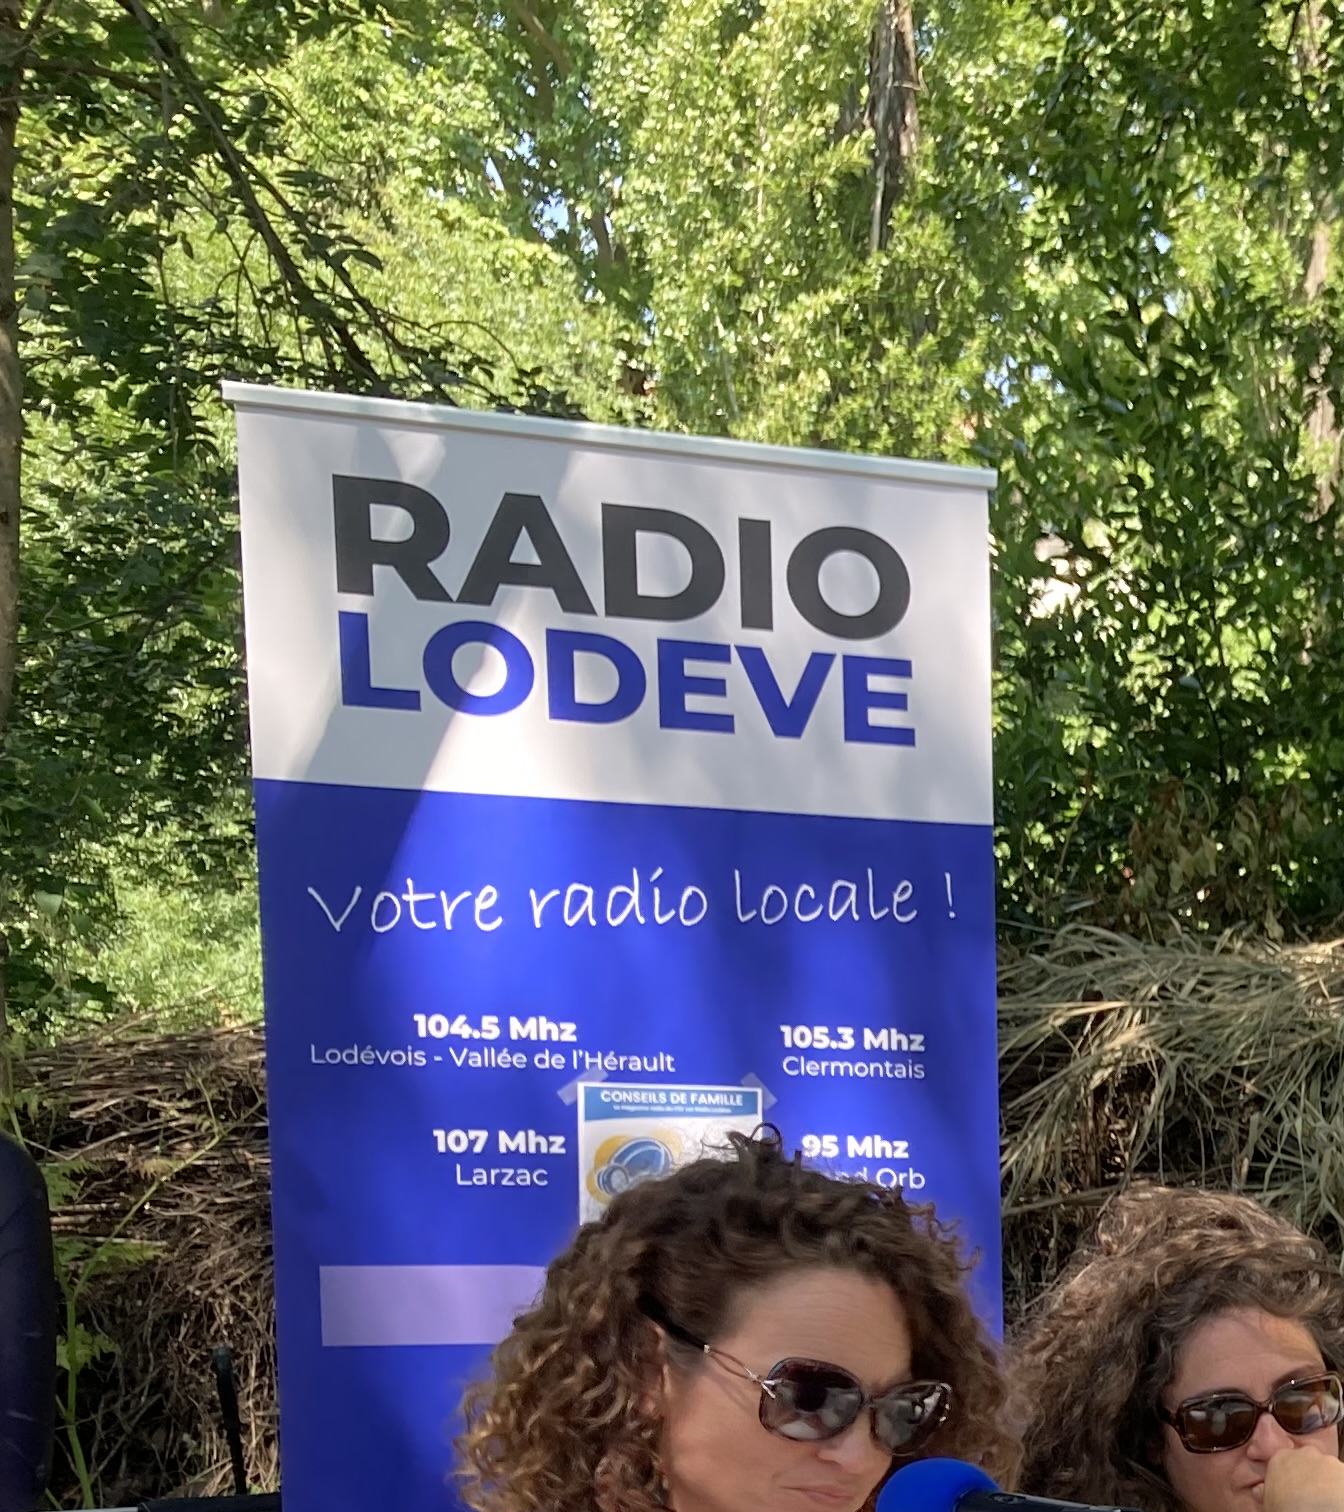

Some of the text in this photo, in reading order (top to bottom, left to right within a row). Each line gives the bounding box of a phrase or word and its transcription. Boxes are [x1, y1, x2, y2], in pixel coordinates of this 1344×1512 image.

[332, 474, 911, 641] RADIO
[337, 610, 917, 747] LODEVE
[307, 867, 958, 933] Votre radio locale !
[412, 1013, 578, 1042] 104.5 Mhz
[779, 1024, 926, 1052] 105.3 Mhz
[310, 1043, 427, 1067] Lodévois
[449, 1046, 527, 1069] Vallée
[533, 1048, 566, 1070] de
[782, 1055, 925, 1080] Clermontais
[600, 1089, 744, 1107] CONSEILS DE FAMILLE
[432, 1129, 567, 1155] 107 Mhz
[801, 1133, 910, 1159] 95 Mhz
[455, 1163, 549, 1188] Larzac
[875, 1167, 926, 1190] Orb
